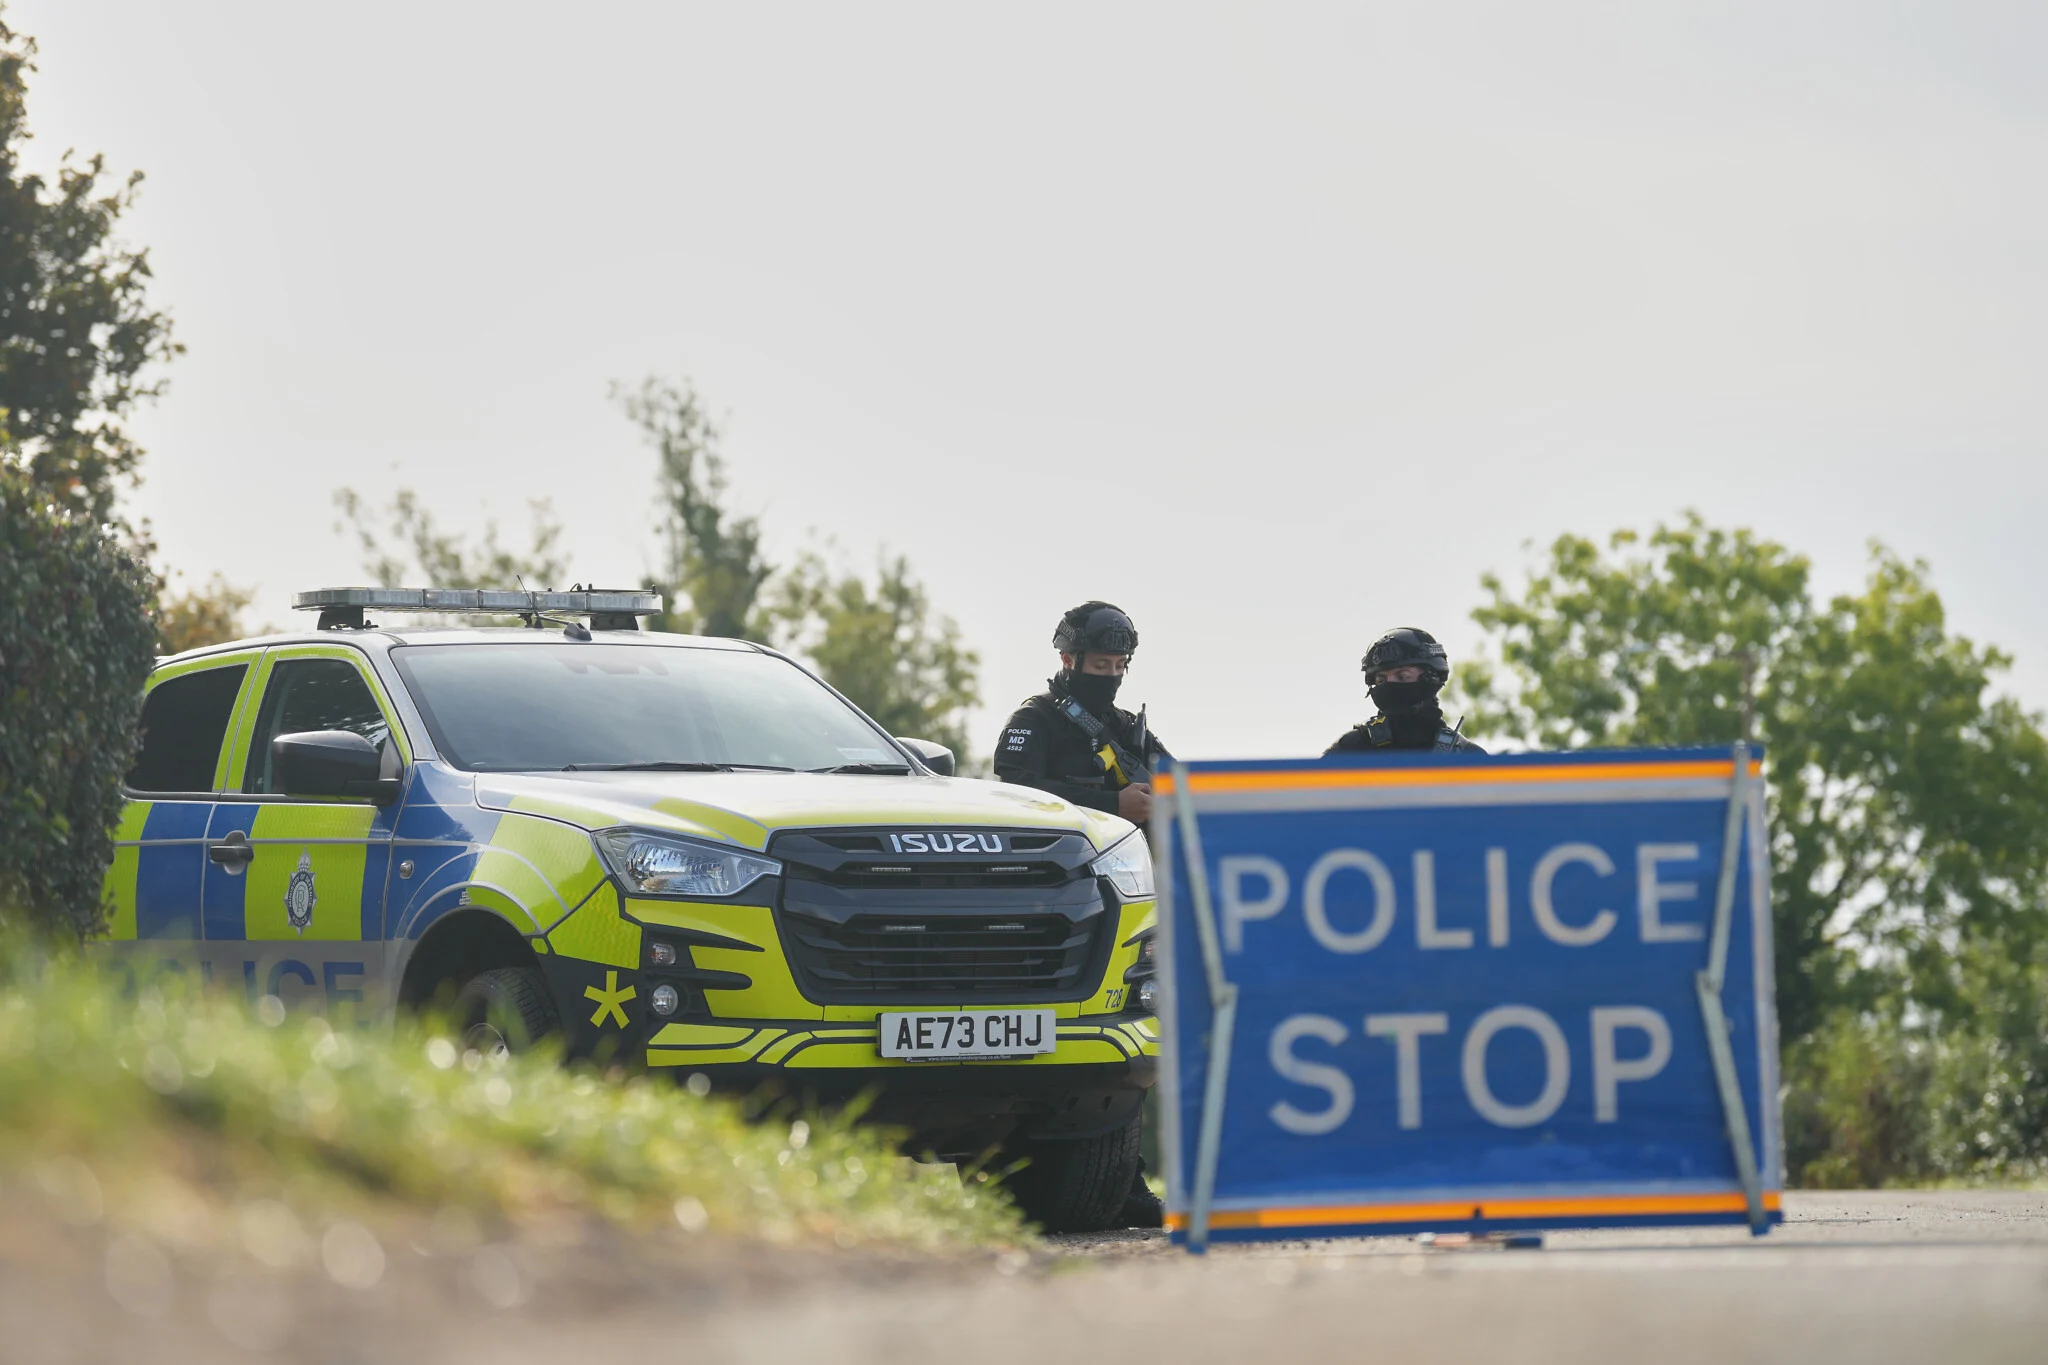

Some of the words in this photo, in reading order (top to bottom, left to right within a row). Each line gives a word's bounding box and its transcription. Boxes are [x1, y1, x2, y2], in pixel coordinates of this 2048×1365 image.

[1009, 736, 1025, 745] MD
[890, 833, 1003, 853] ISUZU
[1218, 842, 1704, 954] POLICE
[98, 958, 372, 1030] ICE
[896, 1015, 975, 1050] AE73
[984, 1014, 1043, 1048] CHJ
[1267, 1004, 1673, 1136] STOP
